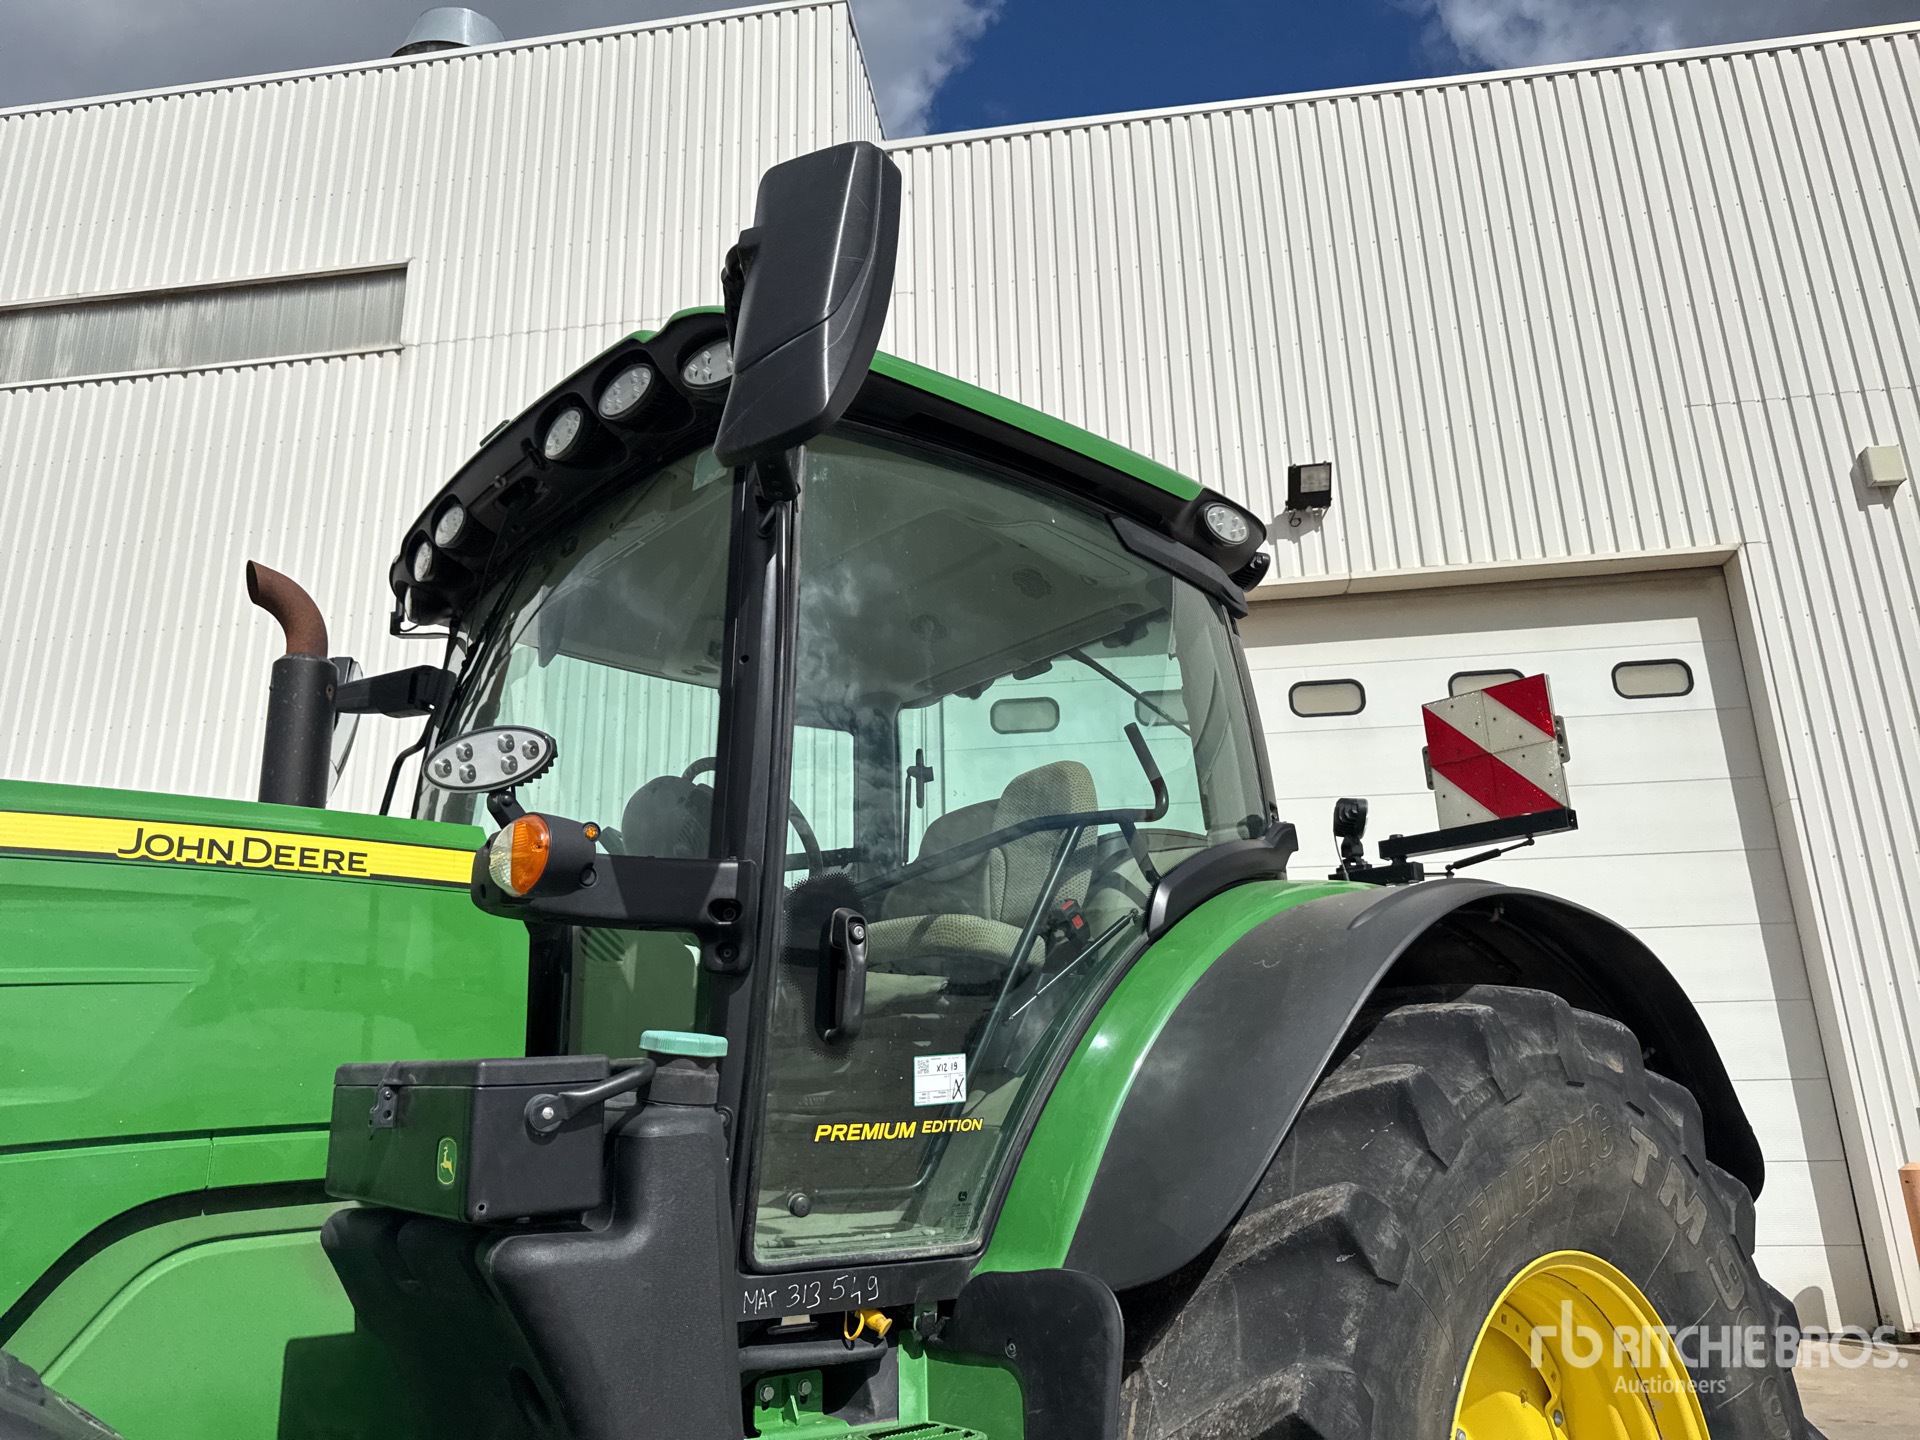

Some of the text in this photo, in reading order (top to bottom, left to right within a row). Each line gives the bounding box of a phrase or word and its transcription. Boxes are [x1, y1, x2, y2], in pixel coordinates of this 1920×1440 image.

[117, 827, 369, 873] JOHN DEERE
[814, 1118, 983, 1143] PREMIUM EDITION
[1419, 1102, 1614, 1302] TRELLEBORG
[742, 1287, 778, 1315] MAT
[786, 1280, 821, 1309] 313
